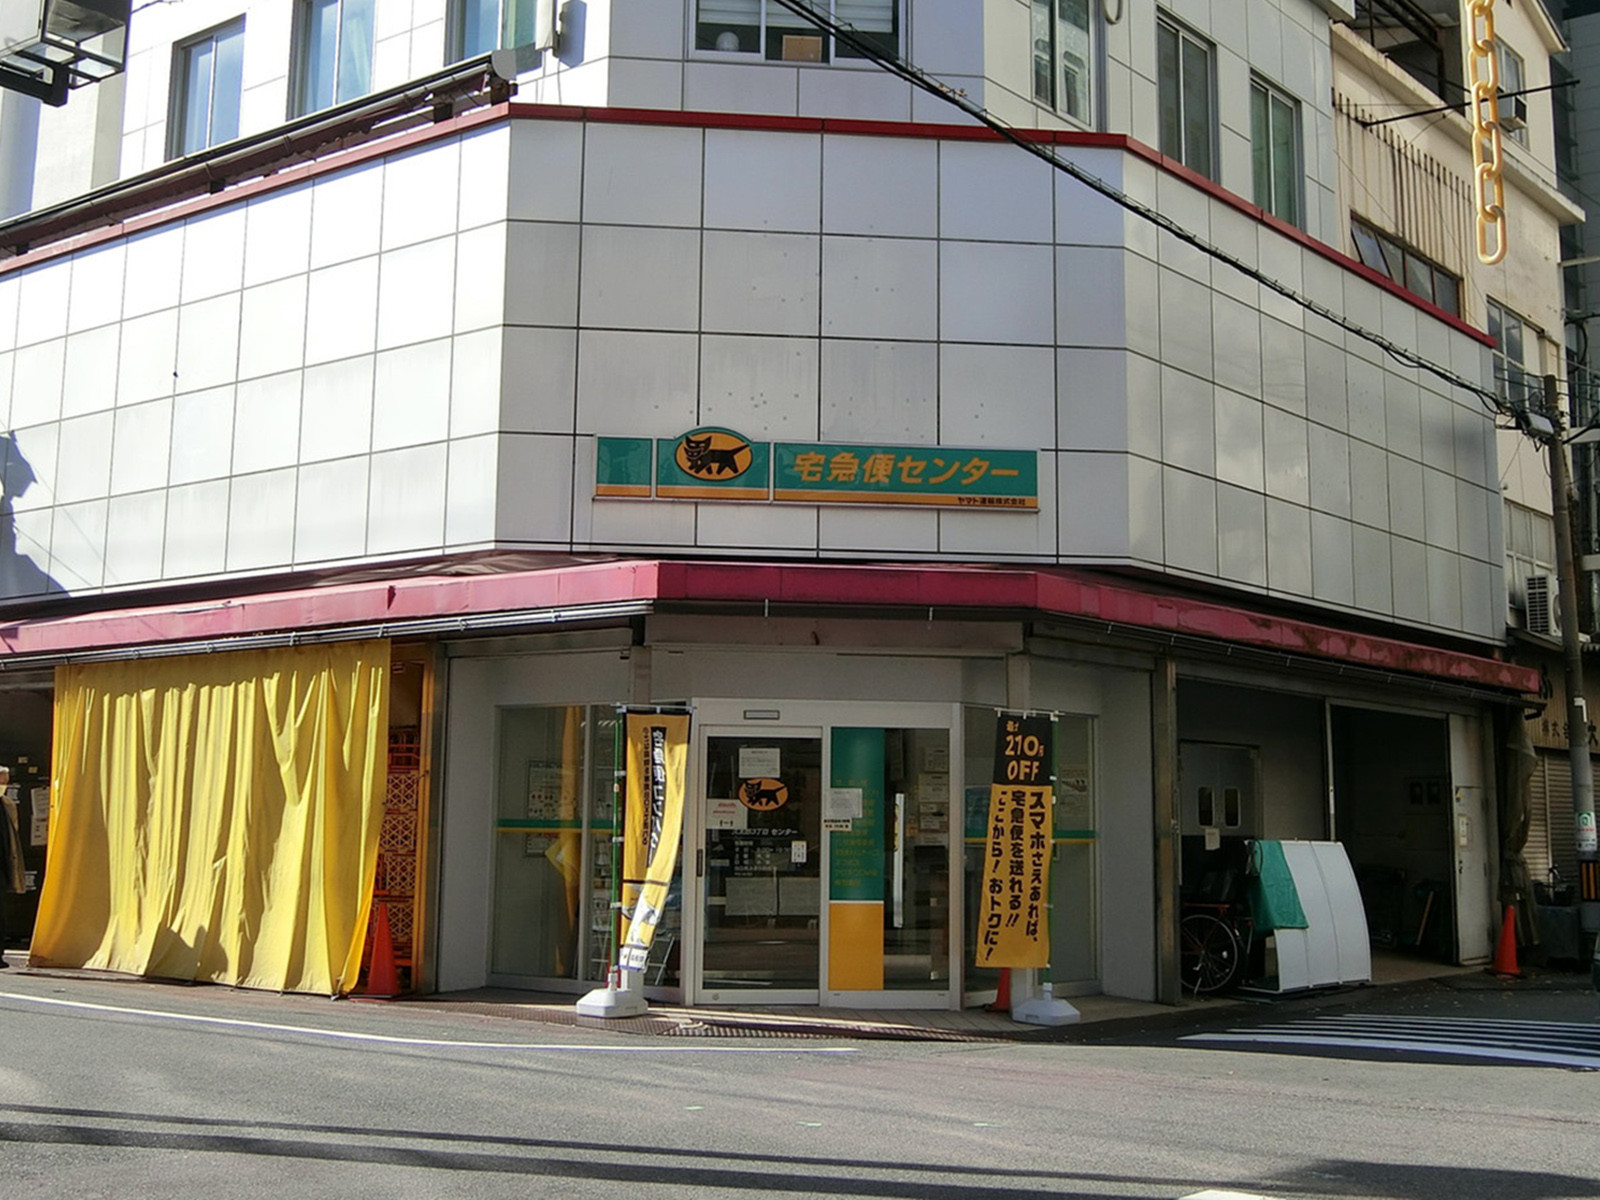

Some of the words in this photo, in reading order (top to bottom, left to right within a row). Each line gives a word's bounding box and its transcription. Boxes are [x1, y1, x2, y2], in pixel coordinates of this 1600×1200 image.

[794, 451, 1020, 485] 宅急便センター
[1007, 759, 1040, 781] OFF
[770, 828, 799, 837] センター
